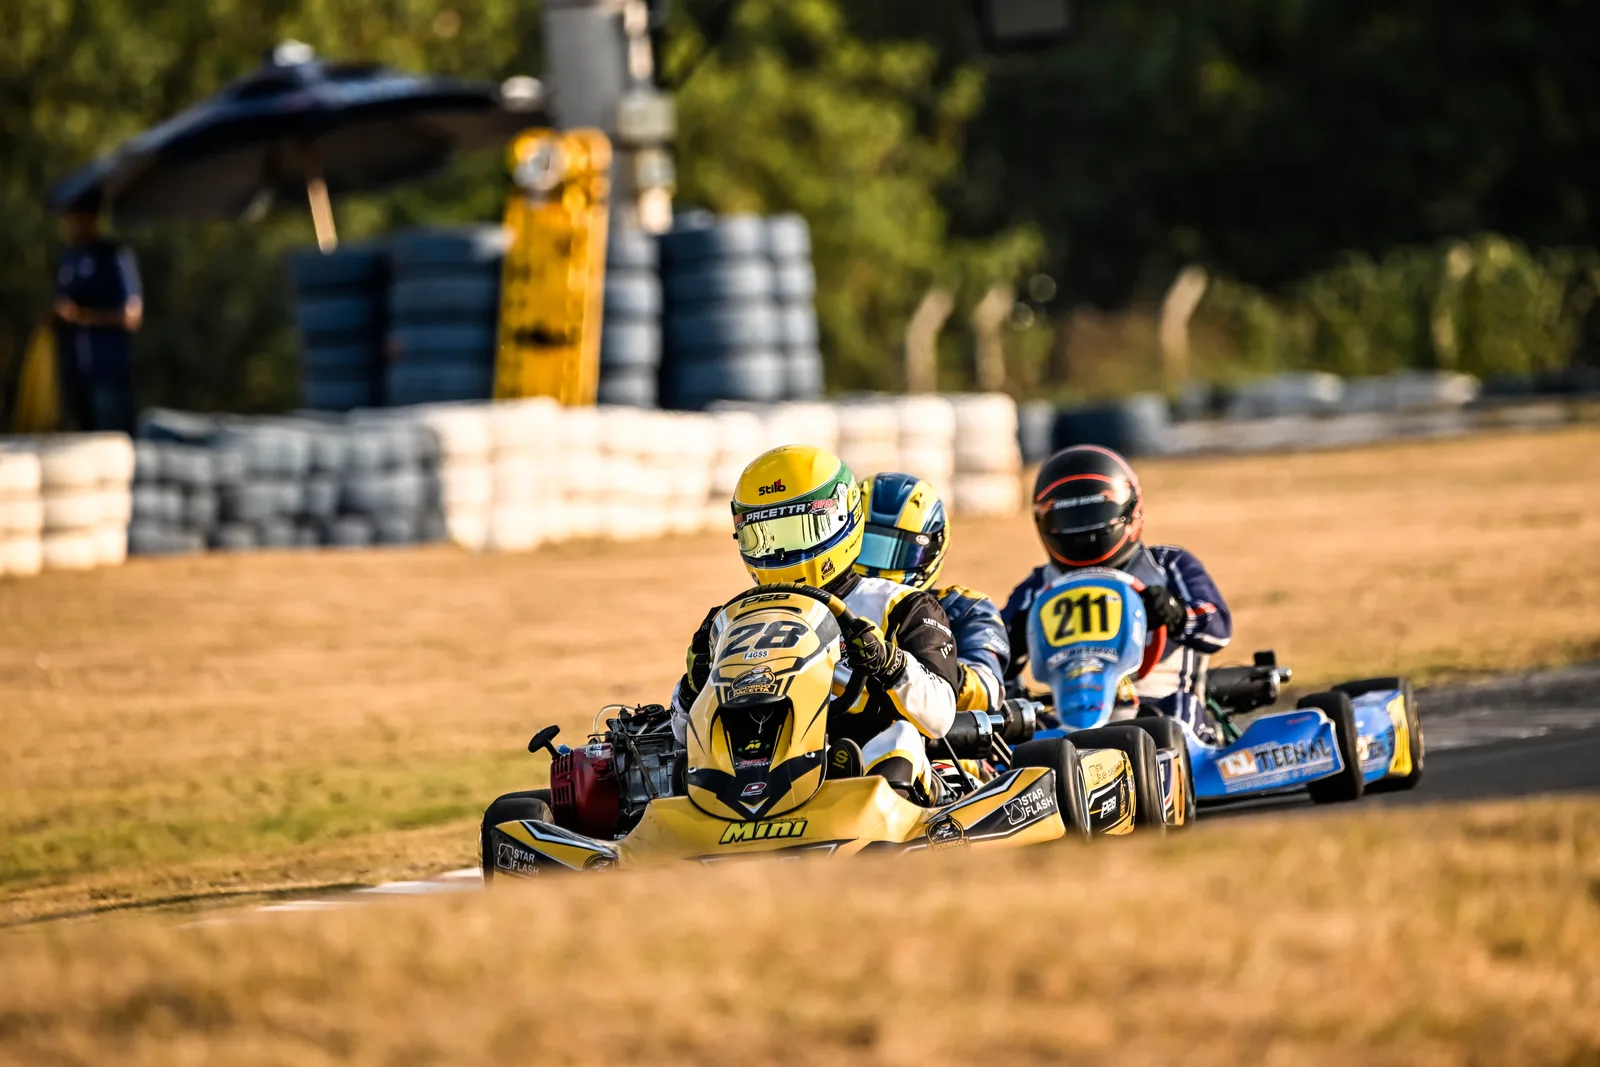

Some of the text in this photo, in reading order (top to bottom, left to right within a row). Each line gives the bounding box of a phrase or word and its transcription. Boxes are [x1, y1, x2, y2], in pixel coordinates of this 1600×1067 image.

[758, 479, 786, 496] Stilo
[746, 503, 807, 523] PACETTA
[740, 593, 792, 609] P28
[1053, 592, 1109, 641] 211
[717, 620, 809, 663] 28
[1020, 788, 1045, 806] STAR
[1026, 797, 1054, 817] FLASH
[719, 820, 808, 845] Mini
[513, 848, 536, 863] STAR
[512, 861, 539, 876] FLASH
